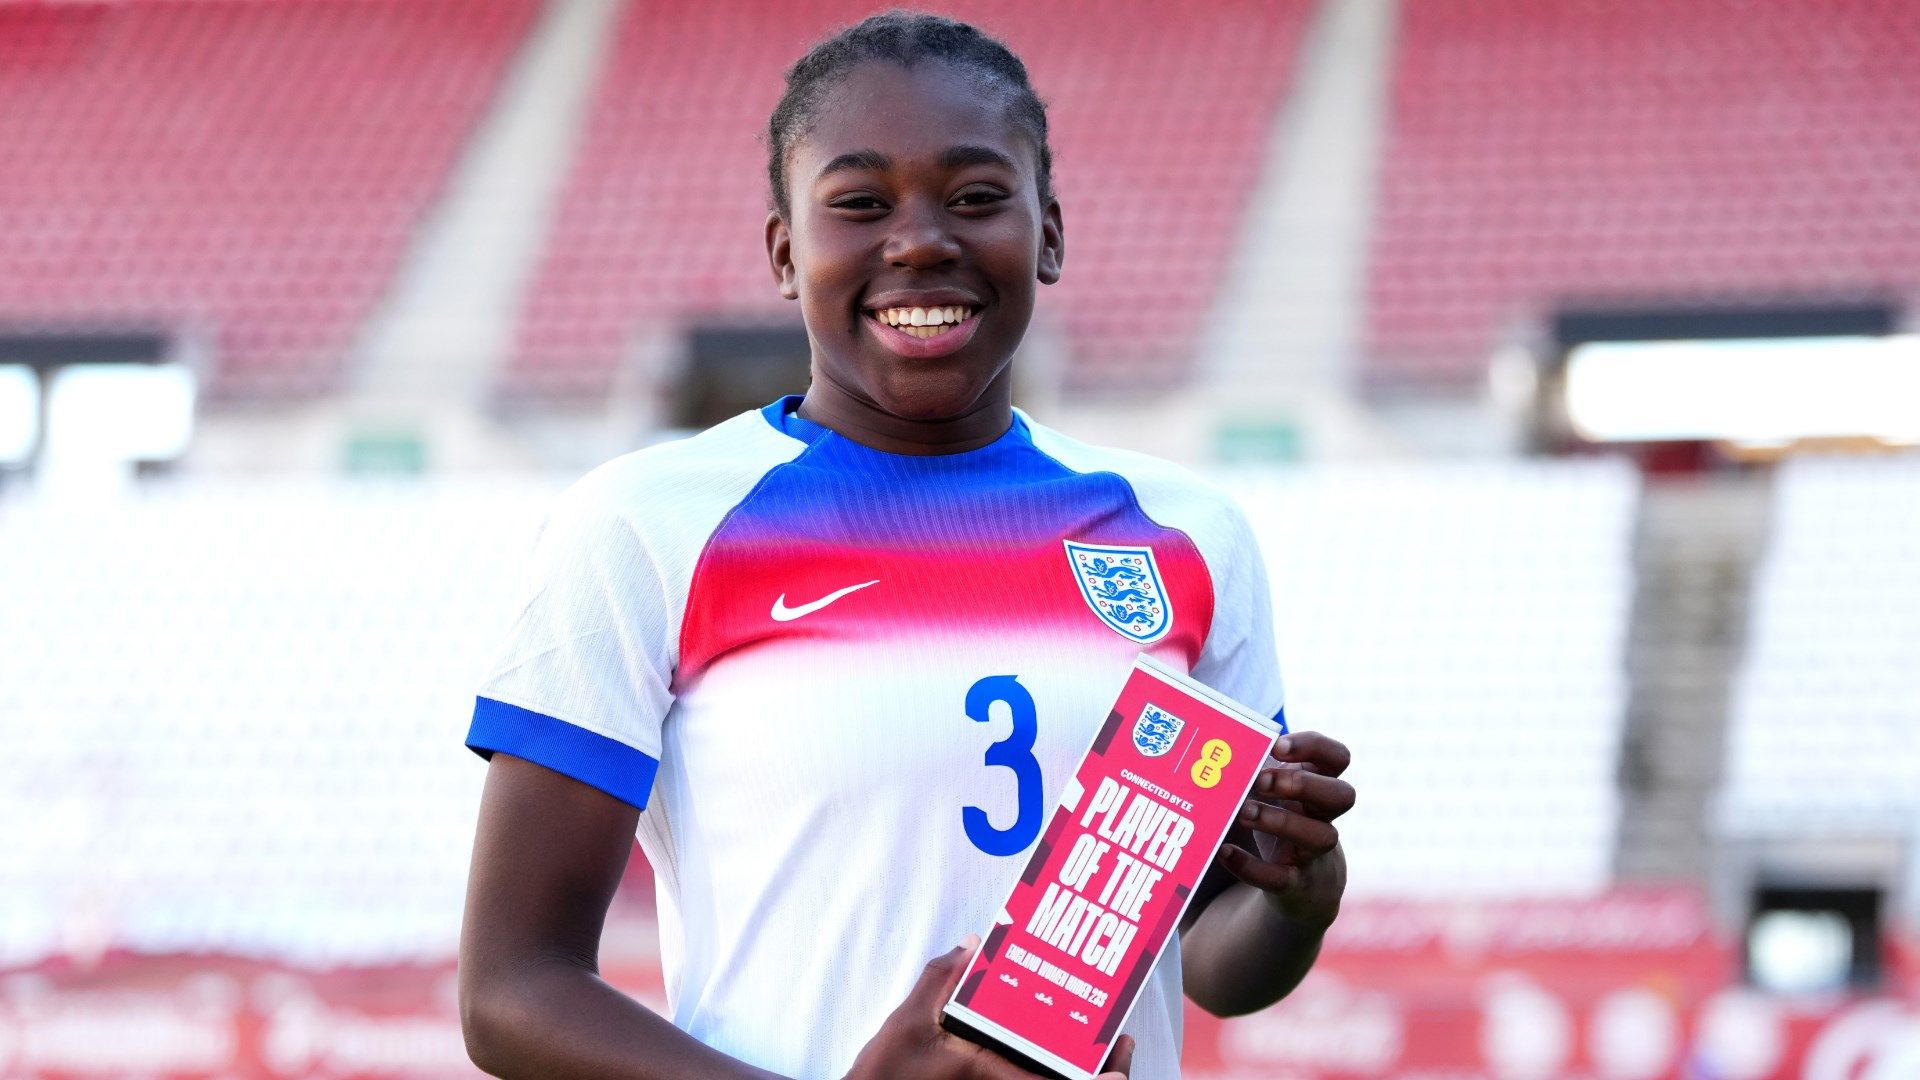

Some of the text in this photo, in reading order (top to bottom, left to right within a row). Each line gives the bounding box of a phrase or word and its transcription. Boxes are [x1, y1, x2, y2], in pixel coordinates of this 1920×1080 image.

[962, 675, 1043, 857] 3
[1120, 768, 1194, 812] CONNECTED BY EE
[1080, 775, 1195, 873] PLAYER
[1059, 833, 1164, 923] OF THE
[1005, 943, 1043, 973] ENGLAND
[1037, 960, 1070, 988] WOMEN
[1064, 974, 1093, 1001] UNDER
[1025, 881, 1139, 977] MATCH
